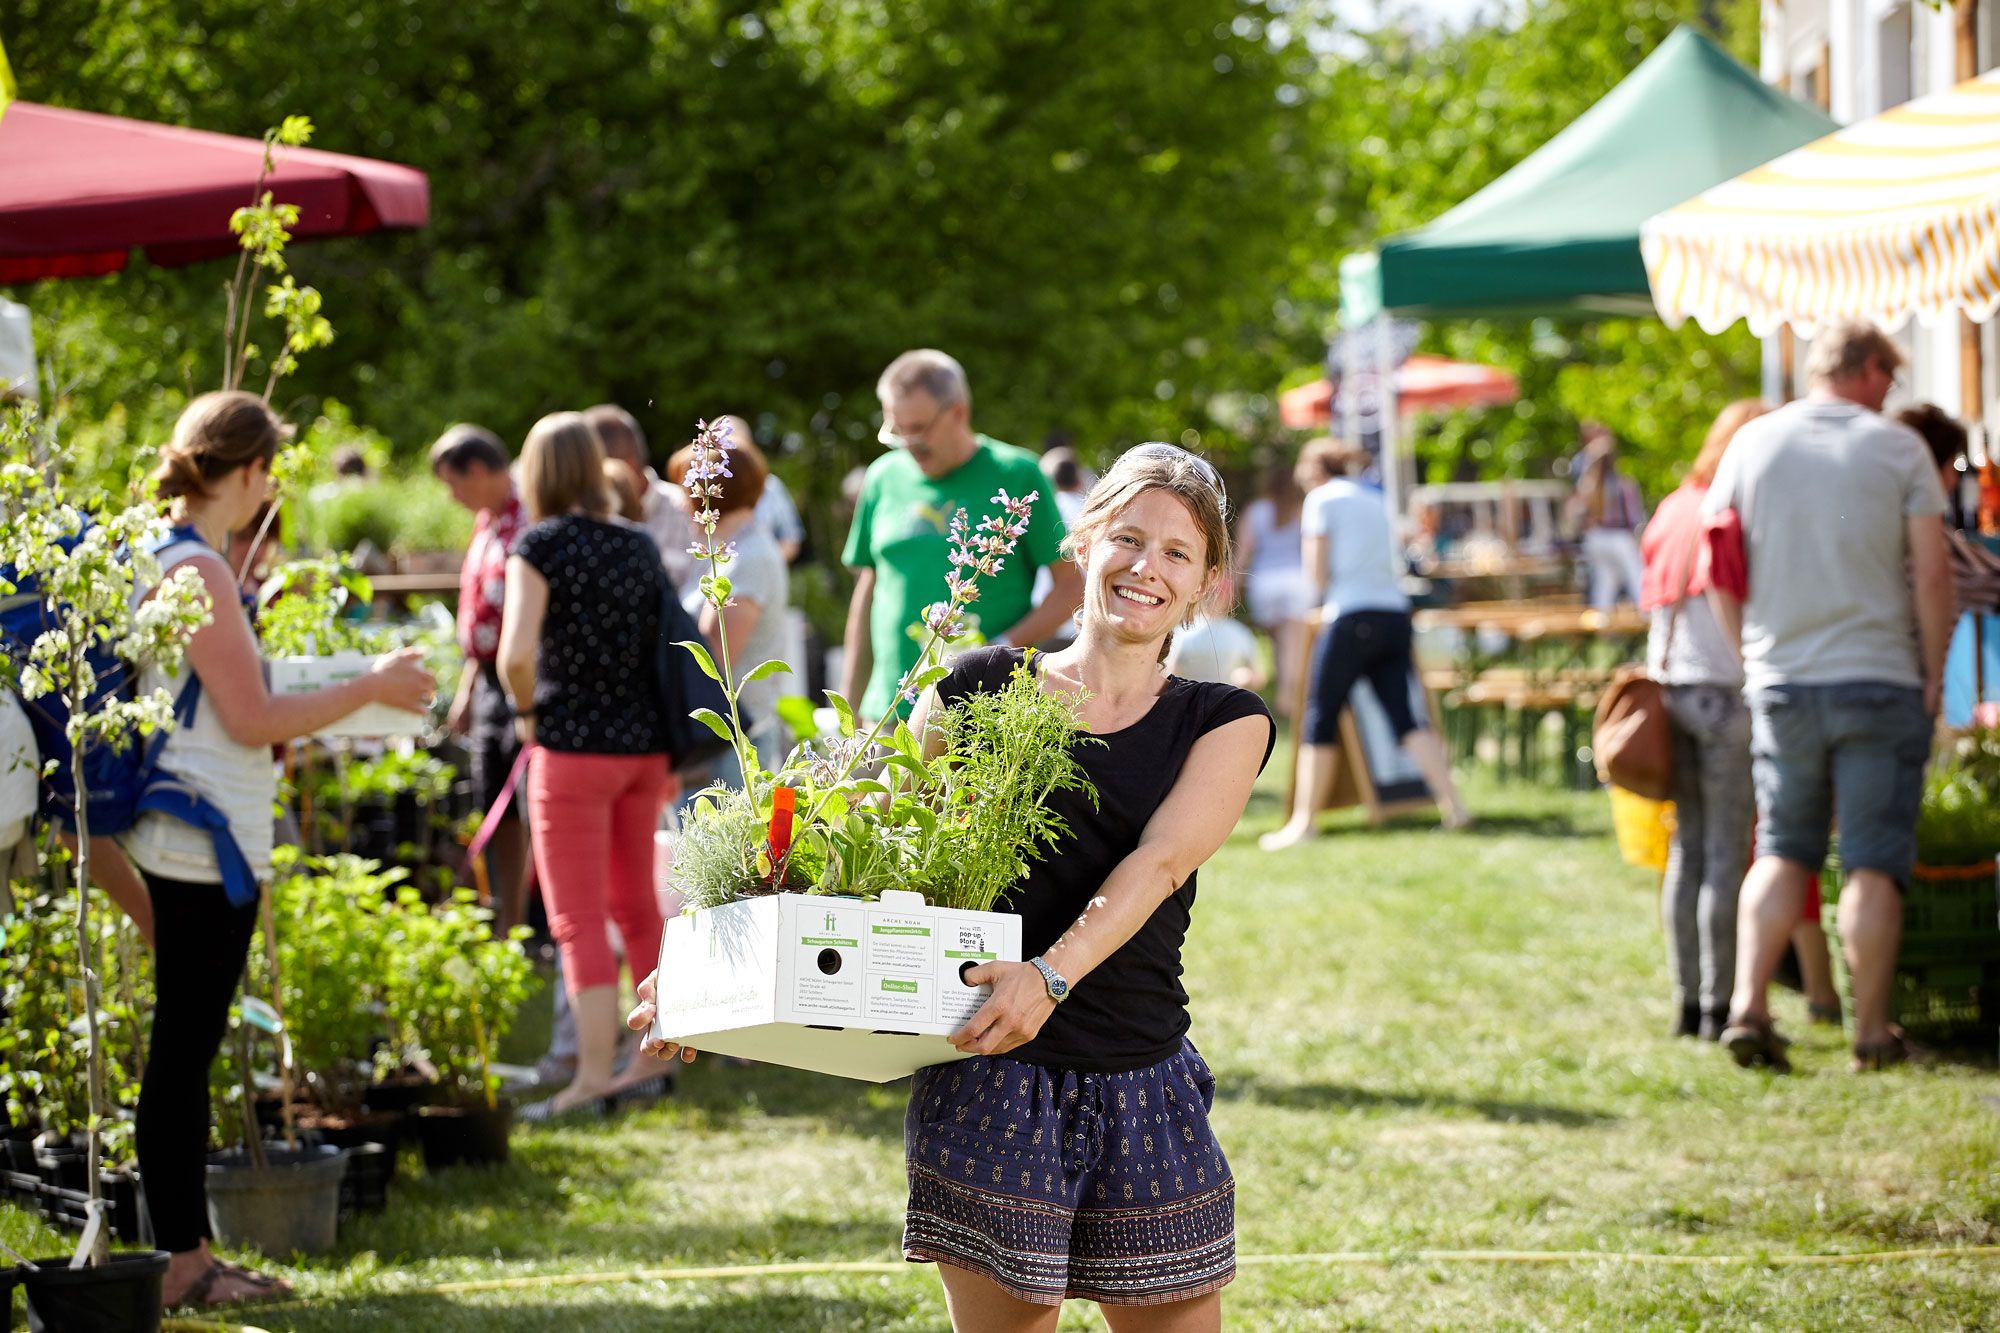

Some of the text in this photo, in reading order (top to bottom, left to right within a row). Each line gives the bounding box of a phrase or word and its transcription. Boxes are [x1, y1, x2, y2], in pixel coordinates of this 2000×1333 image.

[960, 931, 981, 939] pop-up
[960, 937, 976, 945] store
[883, 983, 916, 992] Online-Shop
